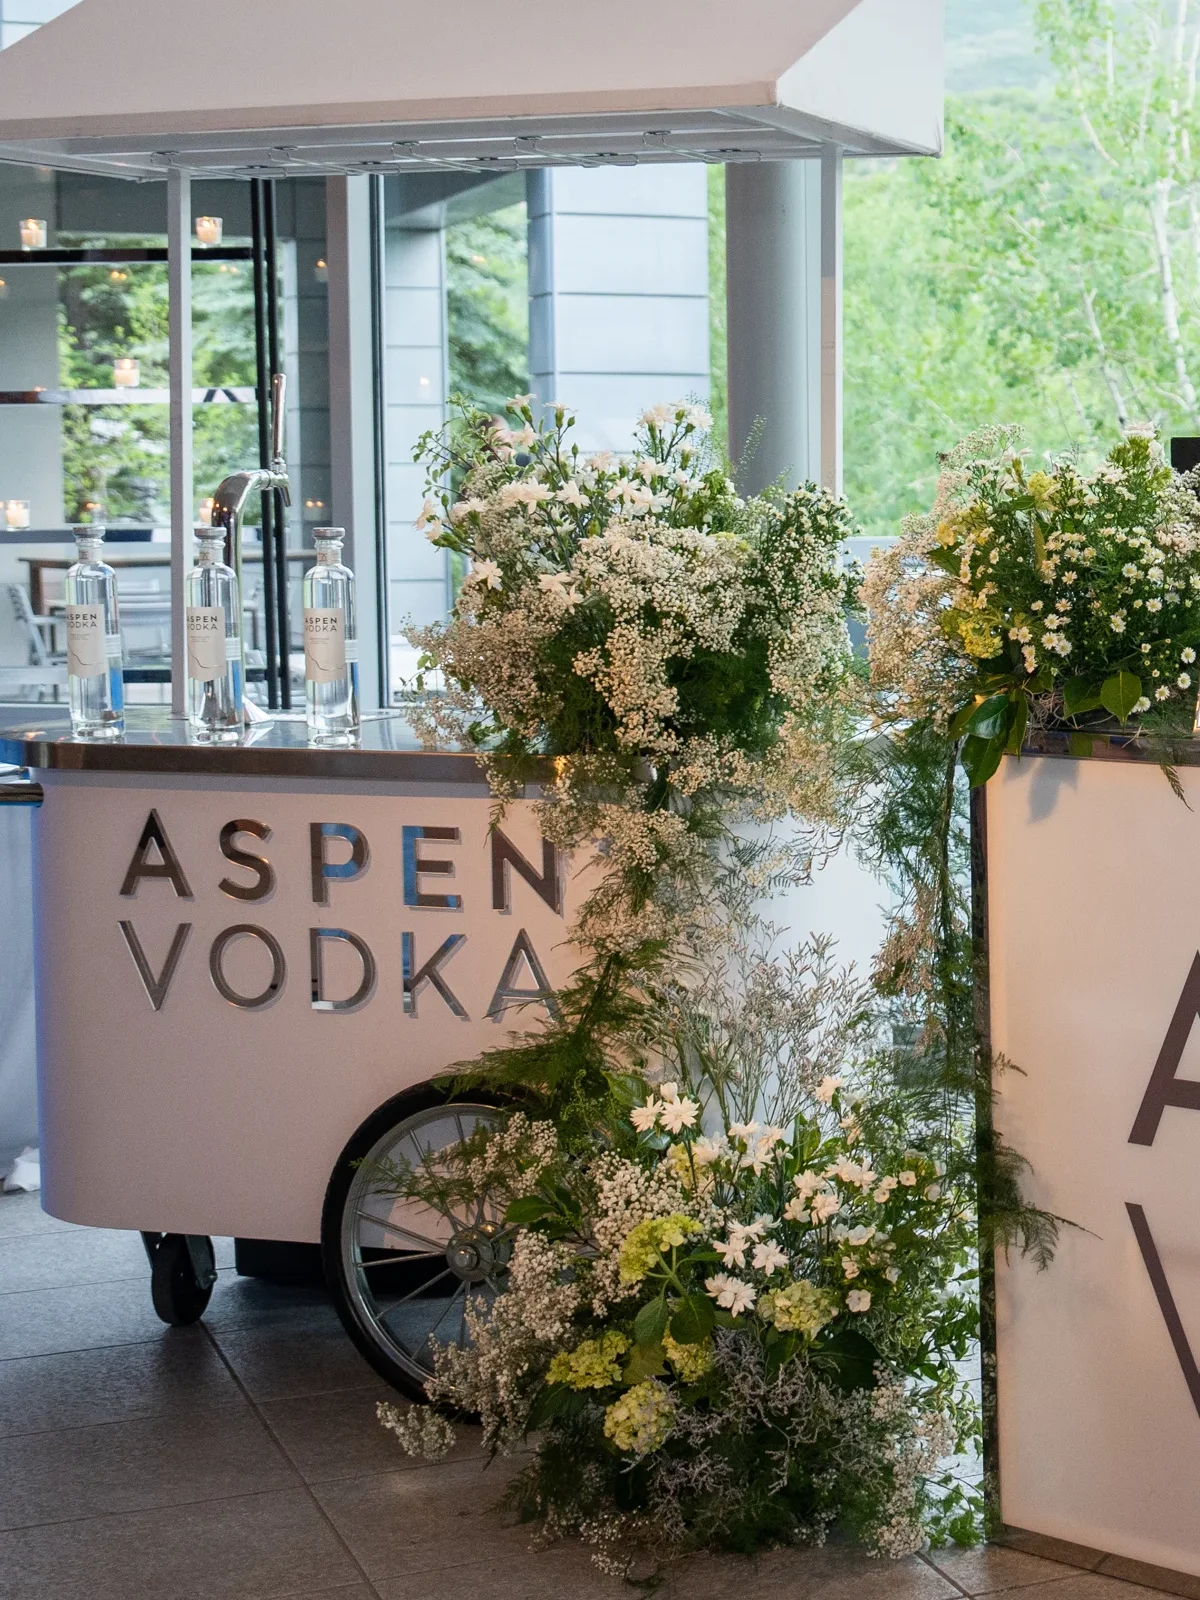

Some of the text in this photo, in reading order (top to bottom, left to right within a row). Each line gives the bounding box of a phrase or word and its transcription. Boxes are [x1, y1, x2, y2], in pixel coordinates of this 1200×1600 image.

[68, 621, 98, 629] ODKA
[188, 623, 218, 631] ODKA
[119, 808, 564, 916] ASPEN
[117, 920, 560, 1022] VODKA
